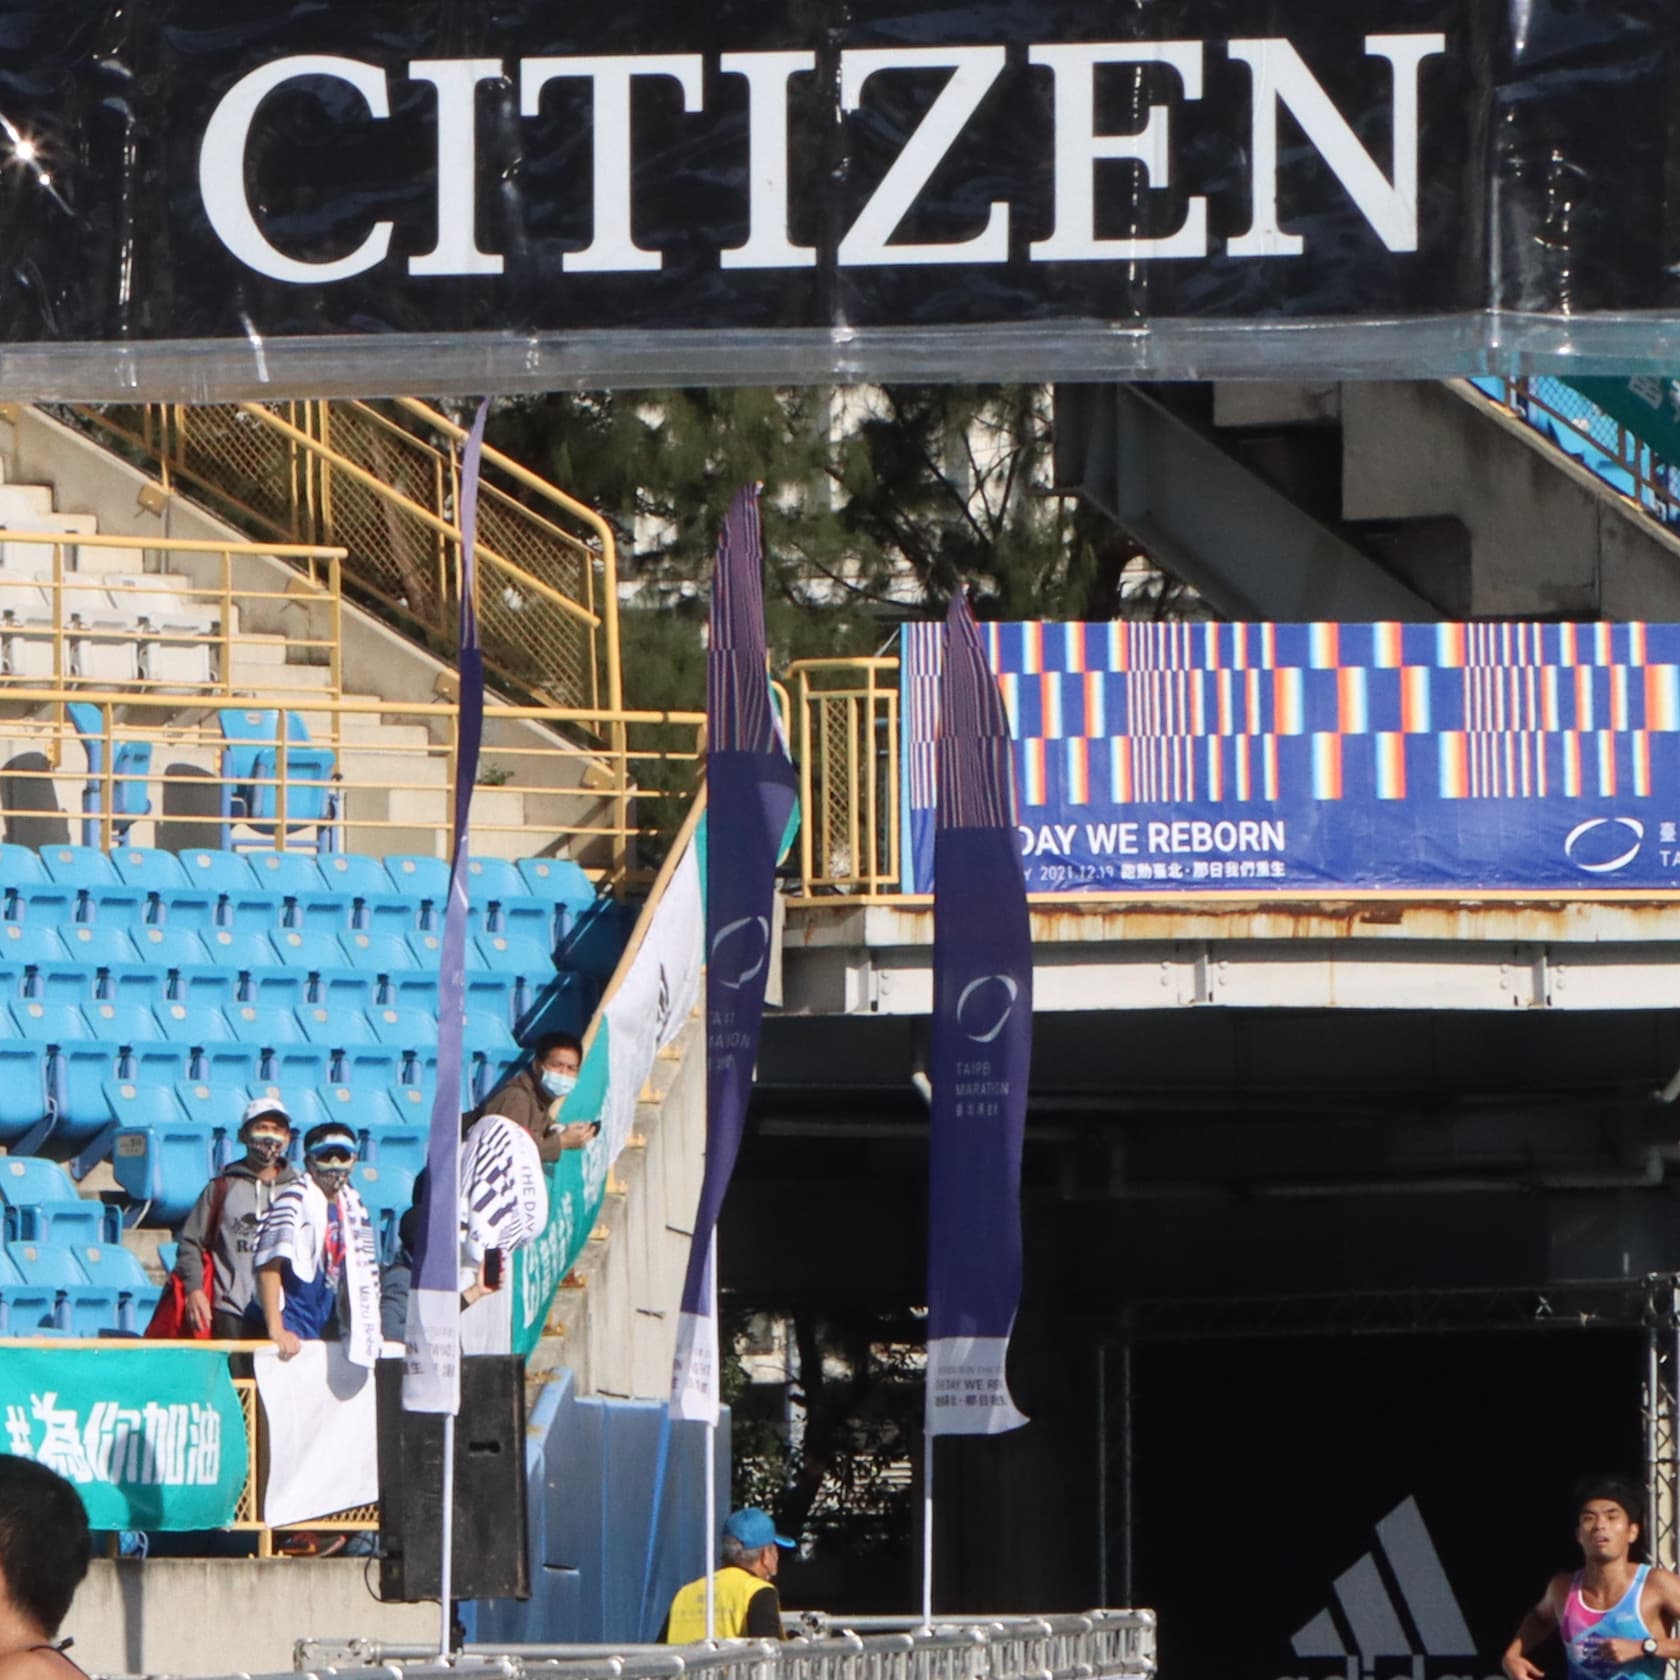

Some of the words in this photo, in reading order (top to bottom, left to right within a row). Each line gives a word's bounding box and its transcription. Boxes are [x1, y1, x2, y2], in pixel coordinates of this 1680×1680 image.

[197, 32, 1445, 285] CITIZEN
[1086, 822, 1139, 856] WE
[1148, 820, 1286, 854] REBORN
[4, 1391, 221, 1486] #為你加油
